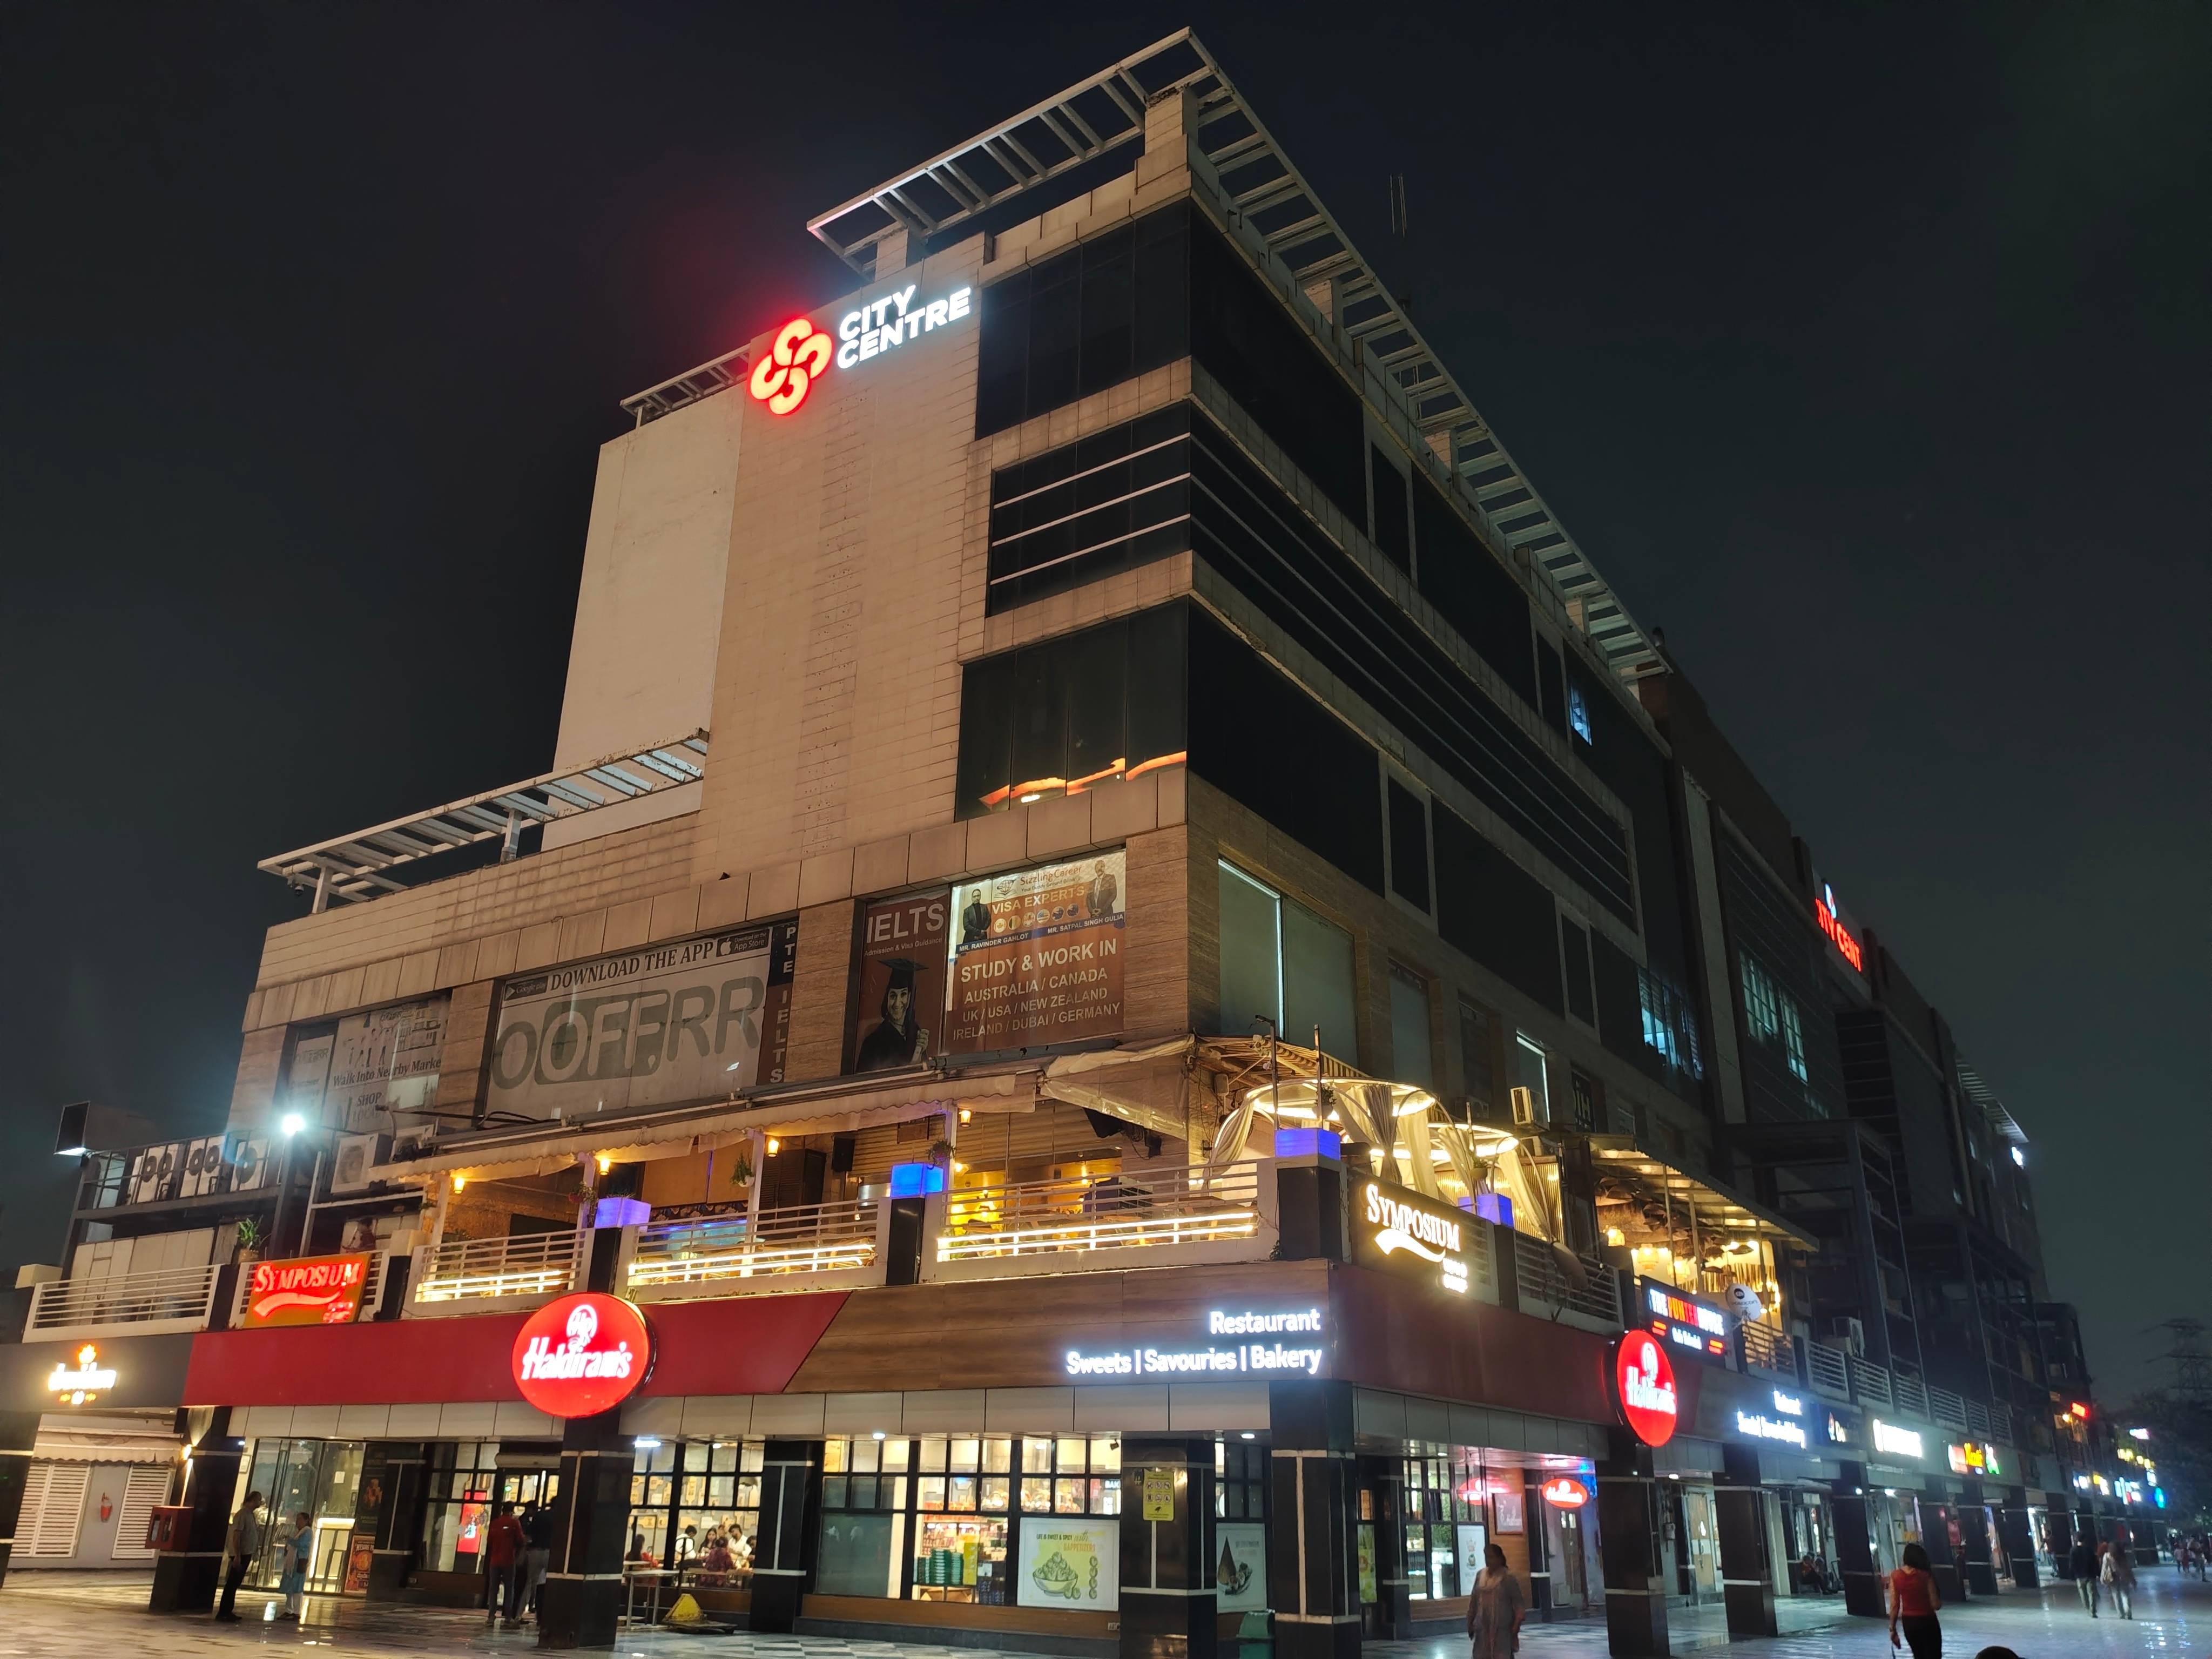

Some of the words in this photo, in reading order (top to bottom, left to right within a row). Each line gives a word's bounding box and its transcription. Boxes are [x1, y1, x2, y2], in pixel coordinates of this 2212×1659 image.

[837, 287, 970, 369] CENTRE
[839, 285, 916, 341] CITY
[1020, 873, 1053, 886] Sizzling
[1054, 867, 1082, 878] Career
[992, 900, 1021, 914] VISA
[1024, 886, 1084, 908] EXPERTS
[866, 903, 944, 943] IELTS
[1060, 922, 1082, 932] SATPAL
[1084, 918, 1103, 927] SINGH
[1105, 914, 1124, 924] GULIA
[734, 942, 747, 951] App
[748, 939, 765, 948] Store
[864, 947, 894, 956] Admission
[915, 938, 942, 947] Guidance
[971, 939, 1002, 950] RAVINDER
[1003, 933, 1029, 943] GAHLOT
[550, 957, 640, 991] DOWNLOAD
[644, 949, 677, 972] THE
[680, 942, 714, 964] APP
[961, 957, 1017, 982] STUDY
[1021, 954, 1033, 972] &
[1038, 942, 1094, 968] WORK
[1100, 938, 1117, 956] IN
[964, 980, 1039, 1004] AUSTRALIA
[1049, 968, 1108, 989] CANADA
[963, 1009, 978, 1022] UK
[988, 1004, 1011, 1019] USA
[1021, 997, 1048, 1012] NEW
[1050, 987, 1108, 1007] ZEALAND
[953, 1022, 1002, 1041] IRELAND
[1013, 1014, 1049, 1031] DUBAI
[1058, 1002, 1121, 1023] GERMANY
[333, 1072, 355, 1087] Walk
[356, 1070, 375, 1082] Into
[357, 1092, 382, 1107] SHOP
[1209, 1309, 1321, 1335] Restaurant
[521, 1337, 633, 1380] Haldiram's
[1066, 1351, 1132, 1375] Sweets
[1144, 1347, 1237, 1373] Savouries
[1251, 1344, 1323, 1374] Bakery
